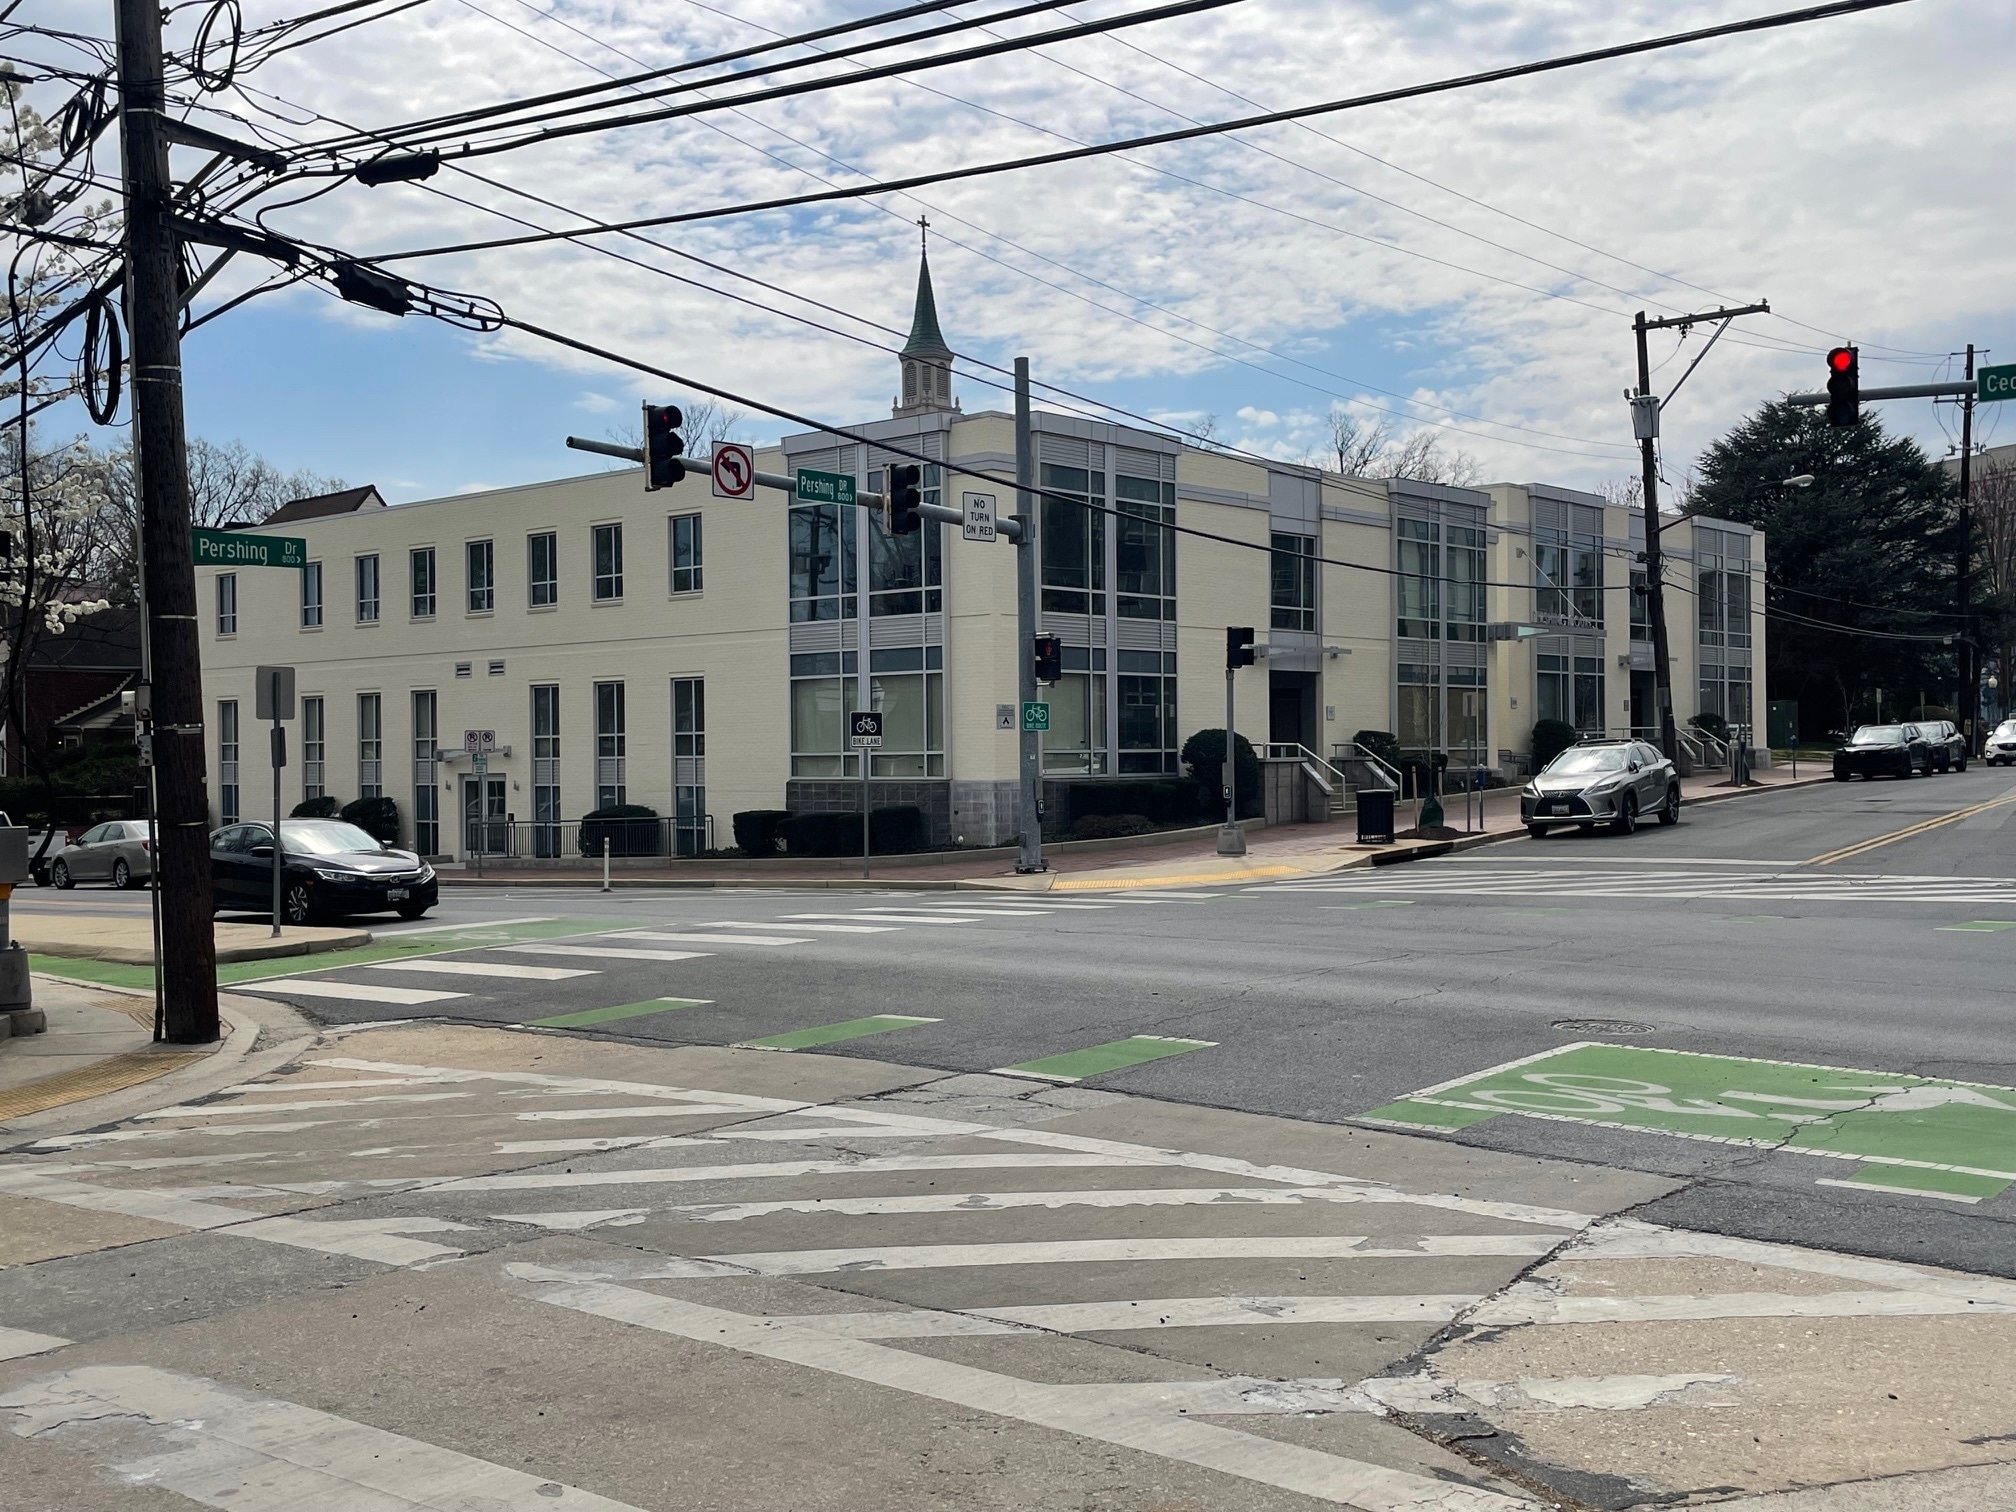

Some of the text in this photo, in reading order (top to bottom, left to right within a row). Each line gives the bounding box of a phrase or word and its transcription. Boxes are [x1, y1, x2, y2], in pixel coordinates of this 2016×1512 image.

[801, 476, 834, 500] Pershing
[837, 492, 849, 501] 800
[973, 499, 985, 509] NO
[970, 512, 990, 522] TURN
[966, 524, 994, 536] ON RED
[199, 538, 298, 566] Pershing Dr
[282, 555, 296, 564] 800
[853, 737, 881, 745] BIKE LANE
